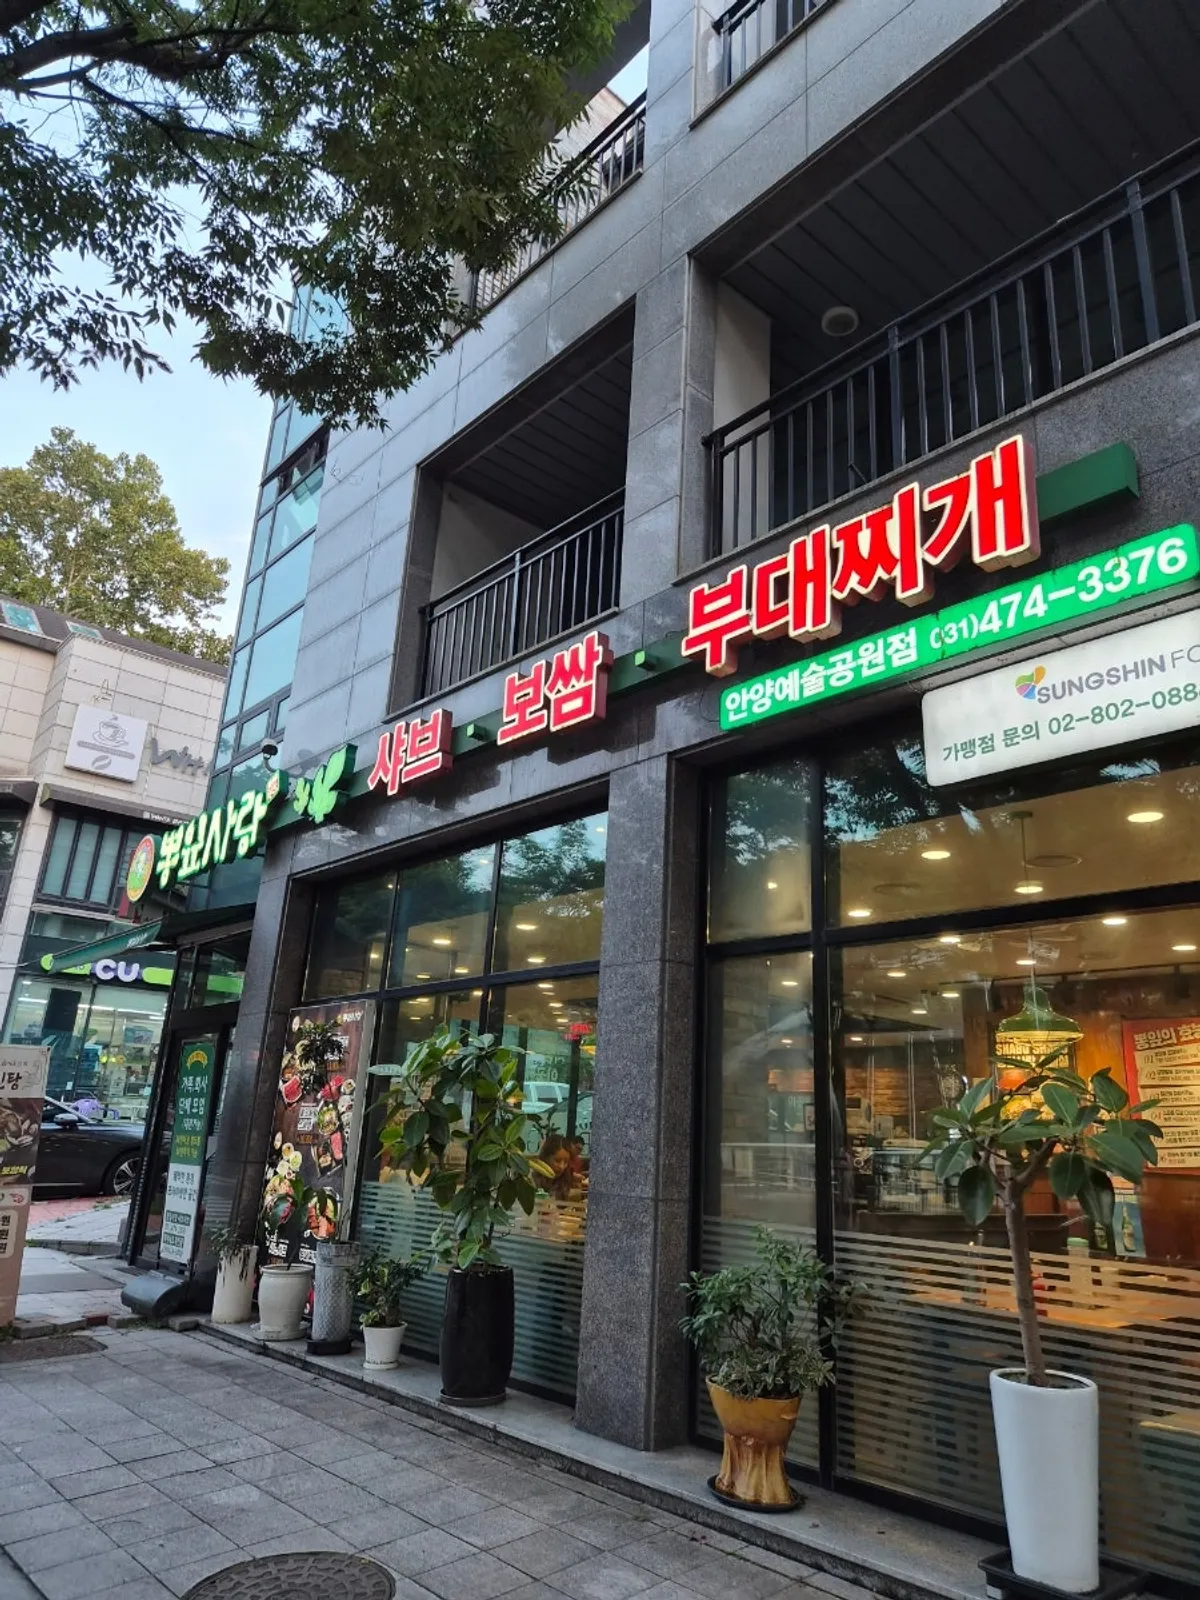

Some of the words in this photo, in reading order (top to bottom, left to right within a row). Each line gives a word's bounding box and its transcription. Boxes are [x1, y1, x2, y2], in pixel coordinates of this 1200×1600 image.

[367, 708, 446, 796] 샤브
[497, 631, 605, 746] 보쌈
[681, 434, 1032, 672] 부대찌개
[724, 626, 918, 723] 안양예술공원점
[1036, 653, 1167, 704] SUNGSHIN
[942, 732, 996, 762] 가맹점
[1001, 720, 1041, 749] 문의
[1048, 681, 1200, 736] 02-802-088
[94, 958, 140, 983] CU
